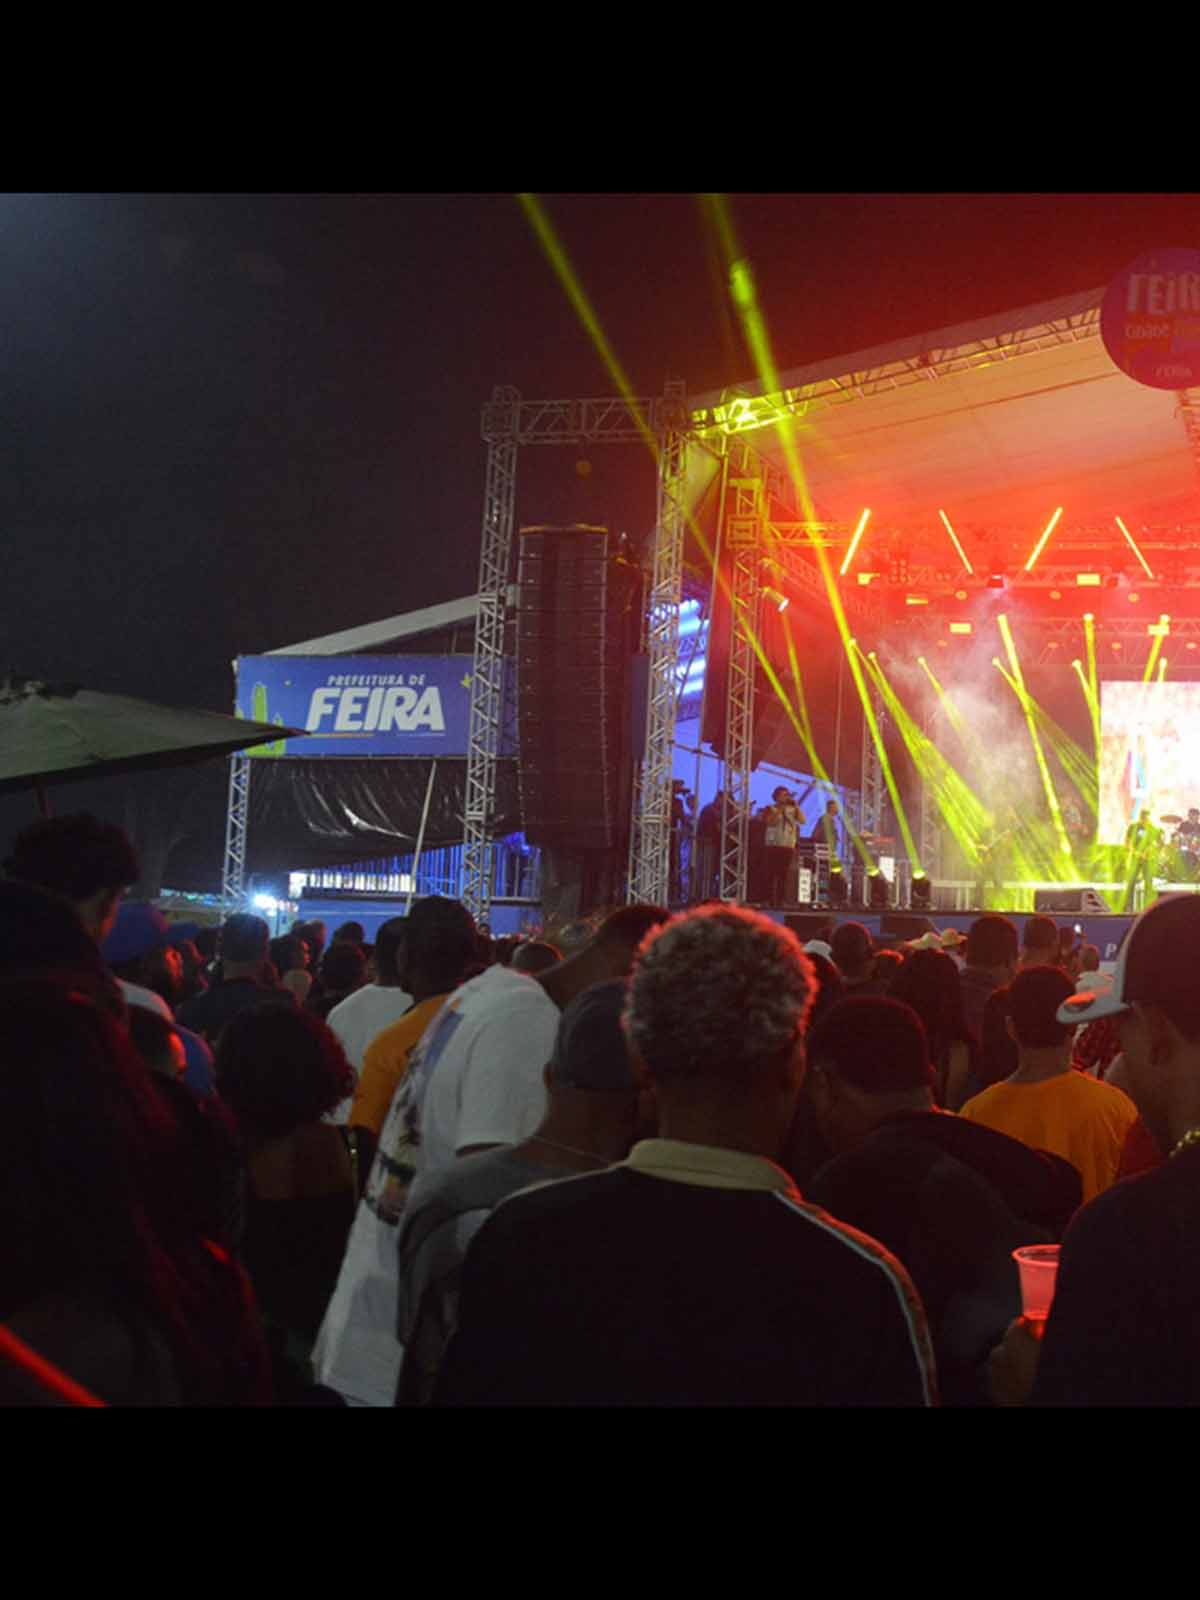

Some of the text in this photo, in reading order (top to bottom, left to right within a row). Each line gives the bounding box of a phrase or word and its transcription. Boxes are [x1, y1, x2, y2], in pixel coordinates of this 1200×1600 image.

[327, 674, 425, 687] PREFEITURA DE
[305, 687, 446, 732] FEIRA
